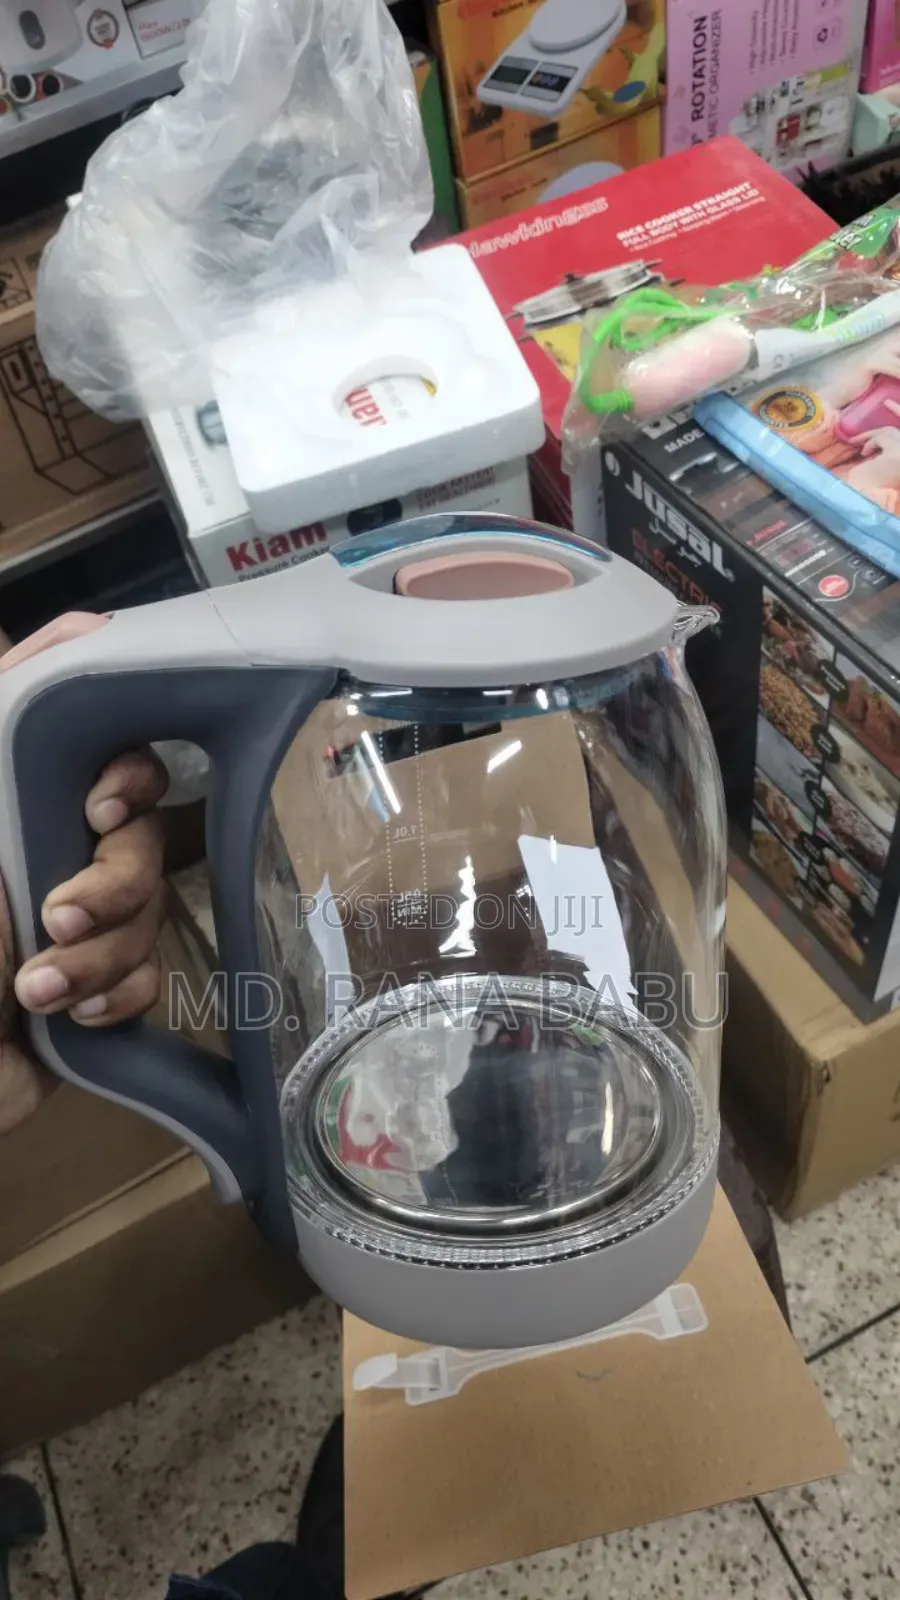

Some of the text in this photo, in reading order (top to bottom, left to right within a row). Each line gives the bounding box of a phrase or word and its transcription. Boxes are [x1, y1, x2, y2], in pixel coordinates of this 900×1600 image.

[691, 16, 708, 122] ROTATION
[709, 9, 721, 94] ORGANIZER
[616, 181, 752, 241] RICE COOKER STRAIGHT
[622, 188, 760, 247] FULL BODY WITH GLASS LID
[226, 521, 327, 571] Kiam
[238, 545, 330, 582] Pressure Cooker
